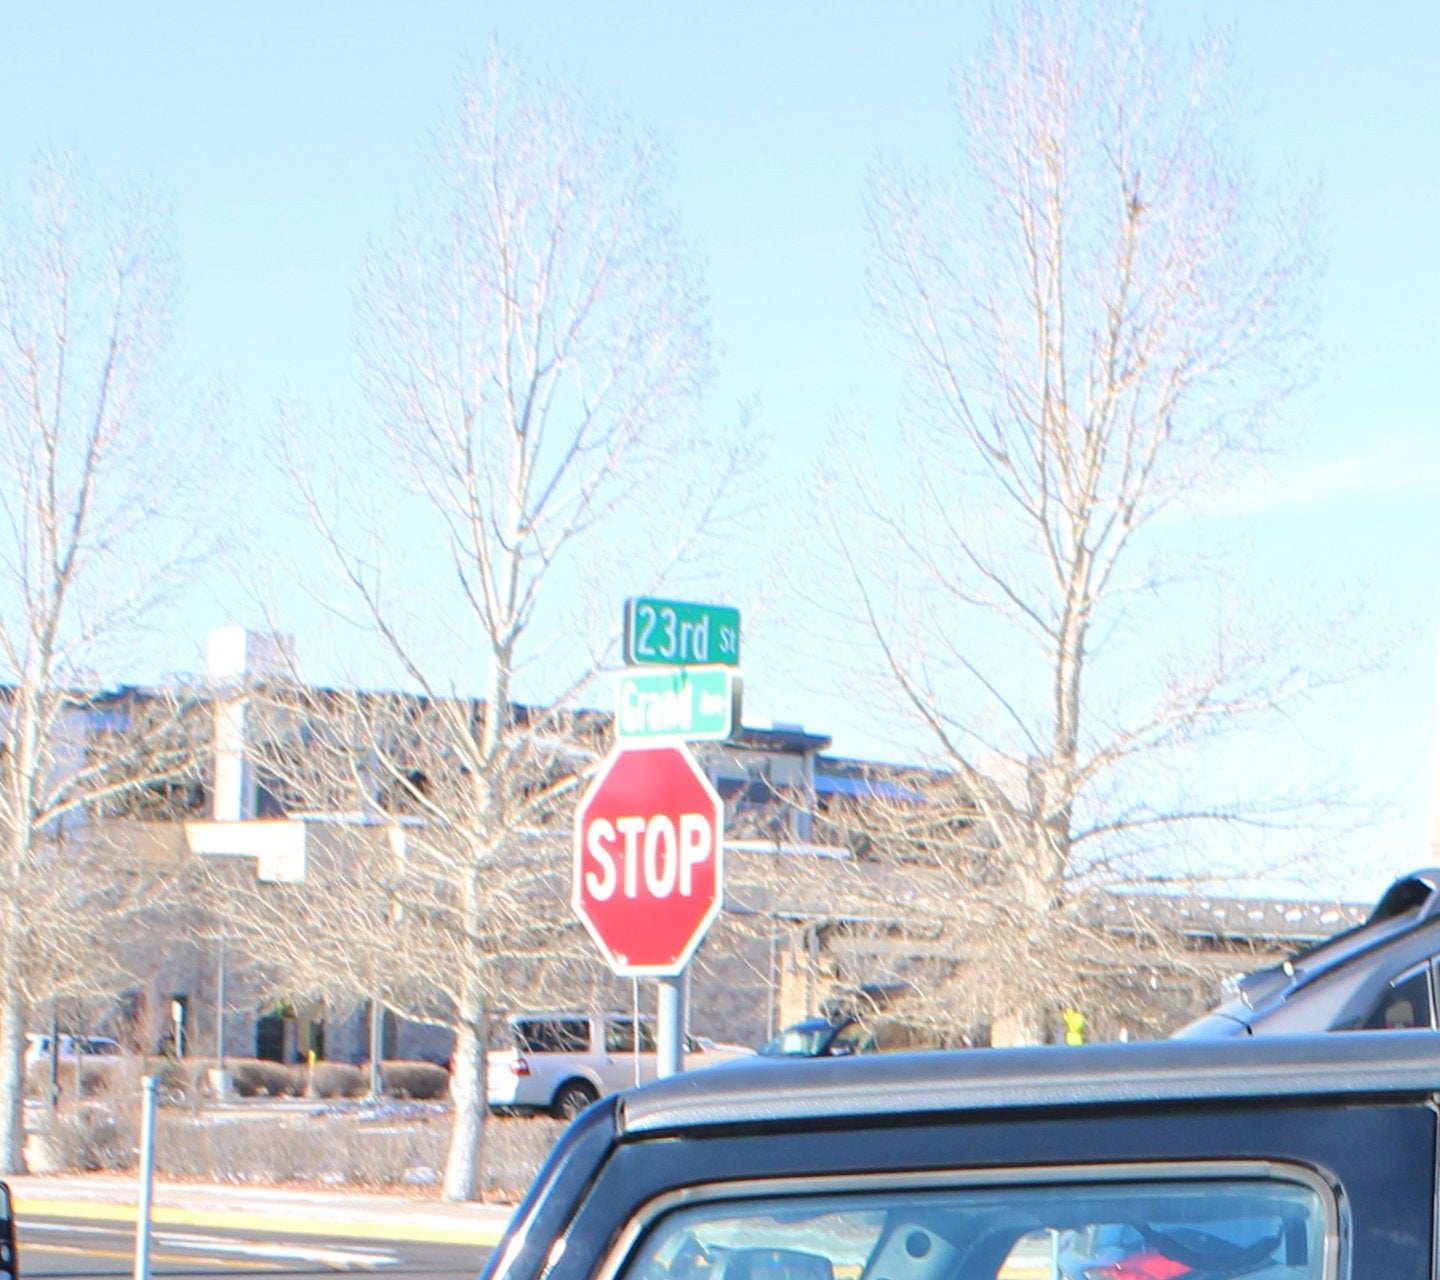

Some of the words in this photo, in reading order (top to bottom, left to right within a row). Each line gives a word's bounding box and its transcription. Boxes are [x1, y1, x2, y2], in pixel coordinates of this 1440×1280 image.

[638, 604, 710, 663] 23rd
[719, 625, 737, 655] St
[620, 679, 694, 734] Grand
[584, 813, 713, 902] STOP
